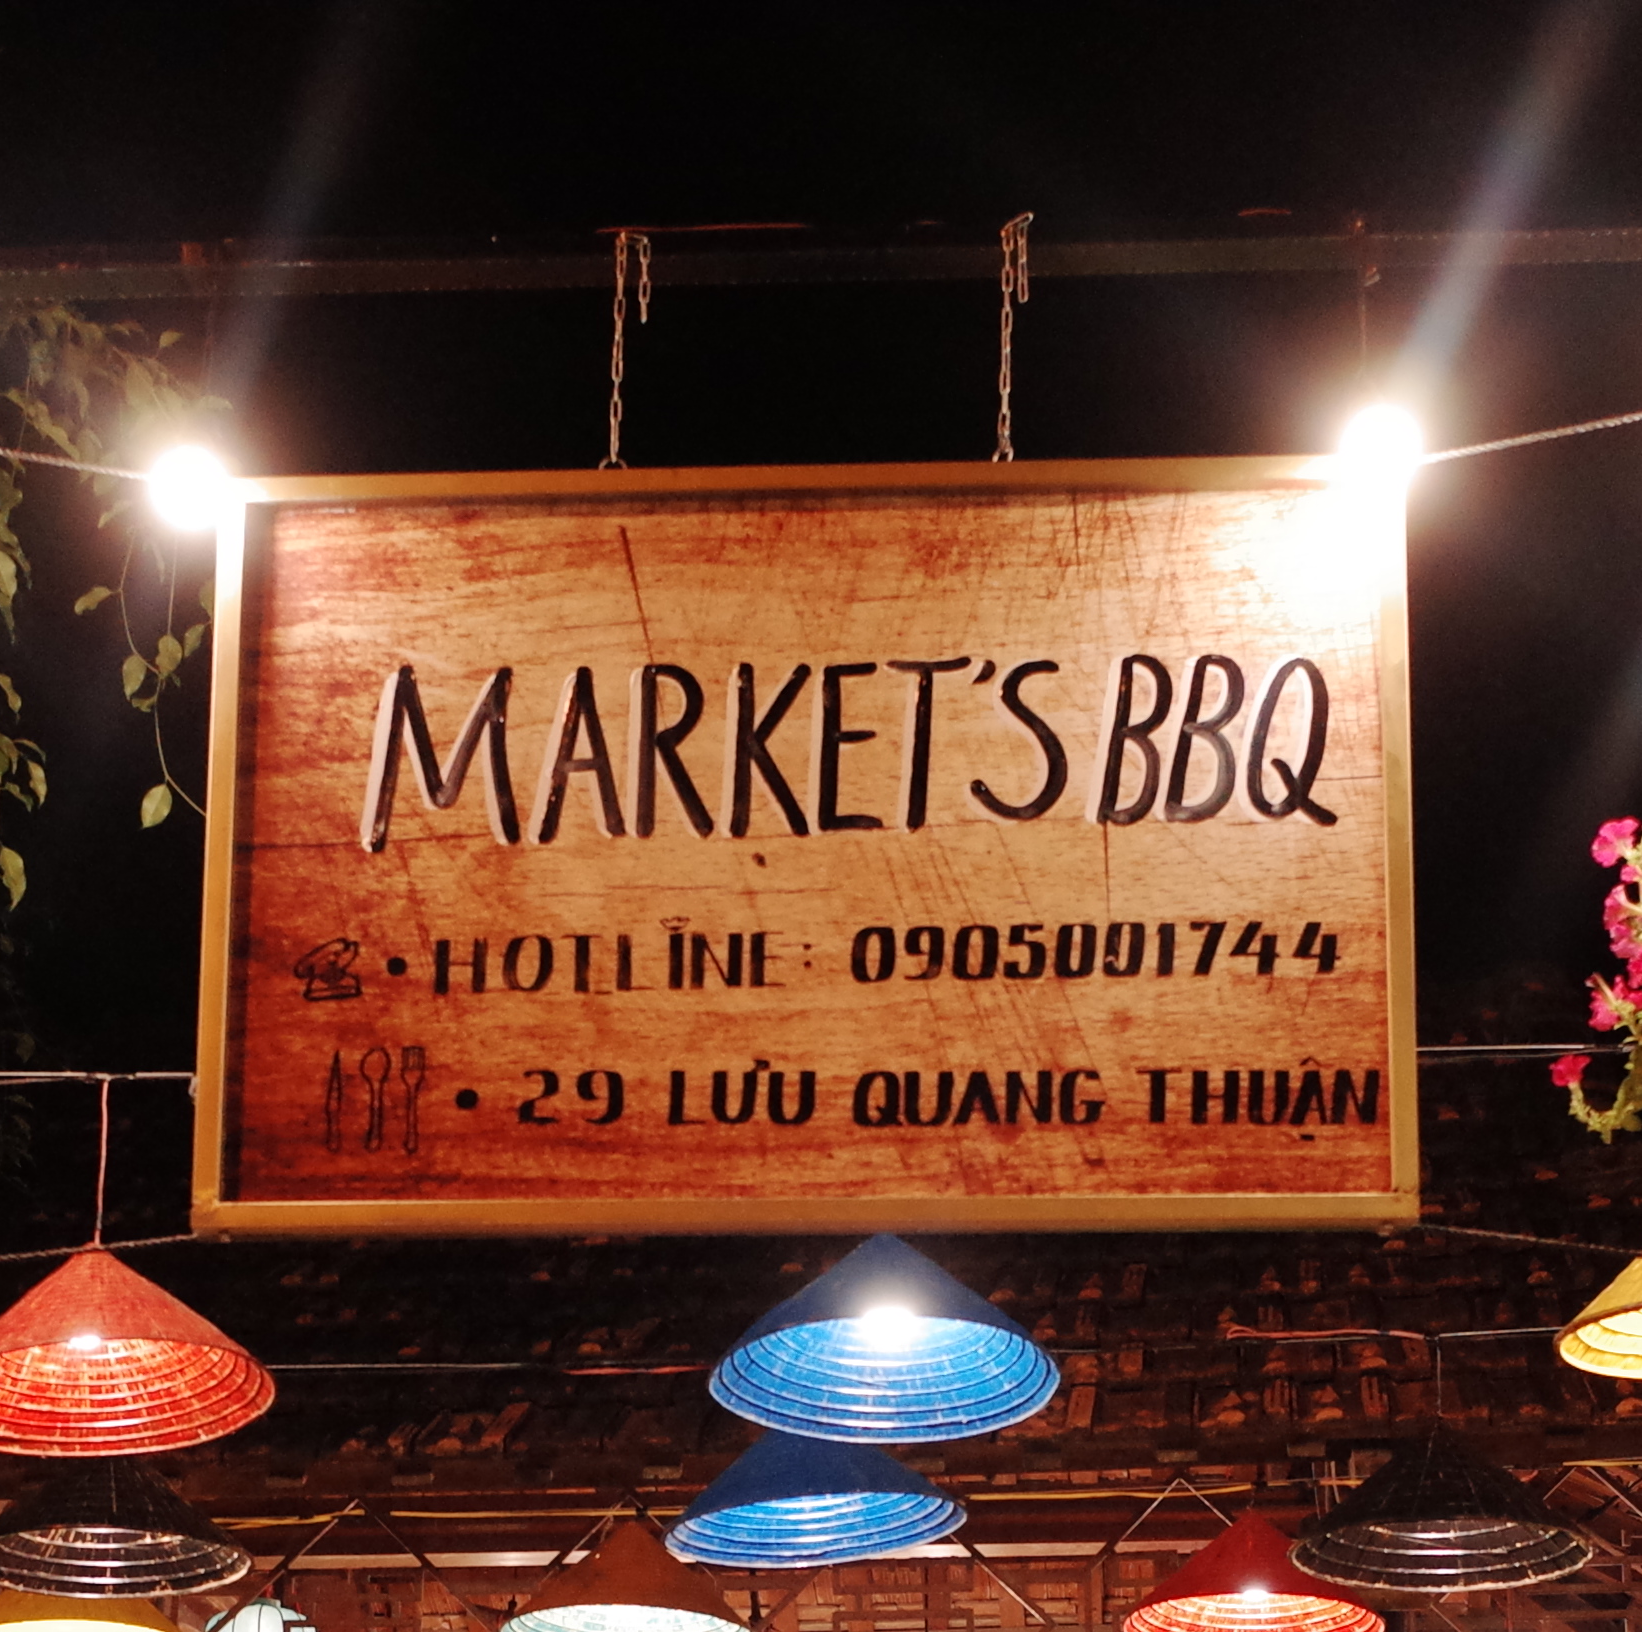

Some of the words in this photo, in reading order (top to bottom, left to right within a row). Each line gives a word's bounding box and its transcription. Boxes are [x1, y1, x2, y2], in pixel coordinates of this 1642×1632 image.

[359, 657, 1069, 853] MARKET'S
[1085, 653, 1339, 828] BBQ
[850, 921, 1342, 983] 0905001744
[516, 1068, 625, 1126] 29
[667, 1058, 817, 1126] LƯU
[852, 1068, 1107, 1128] QUANG
